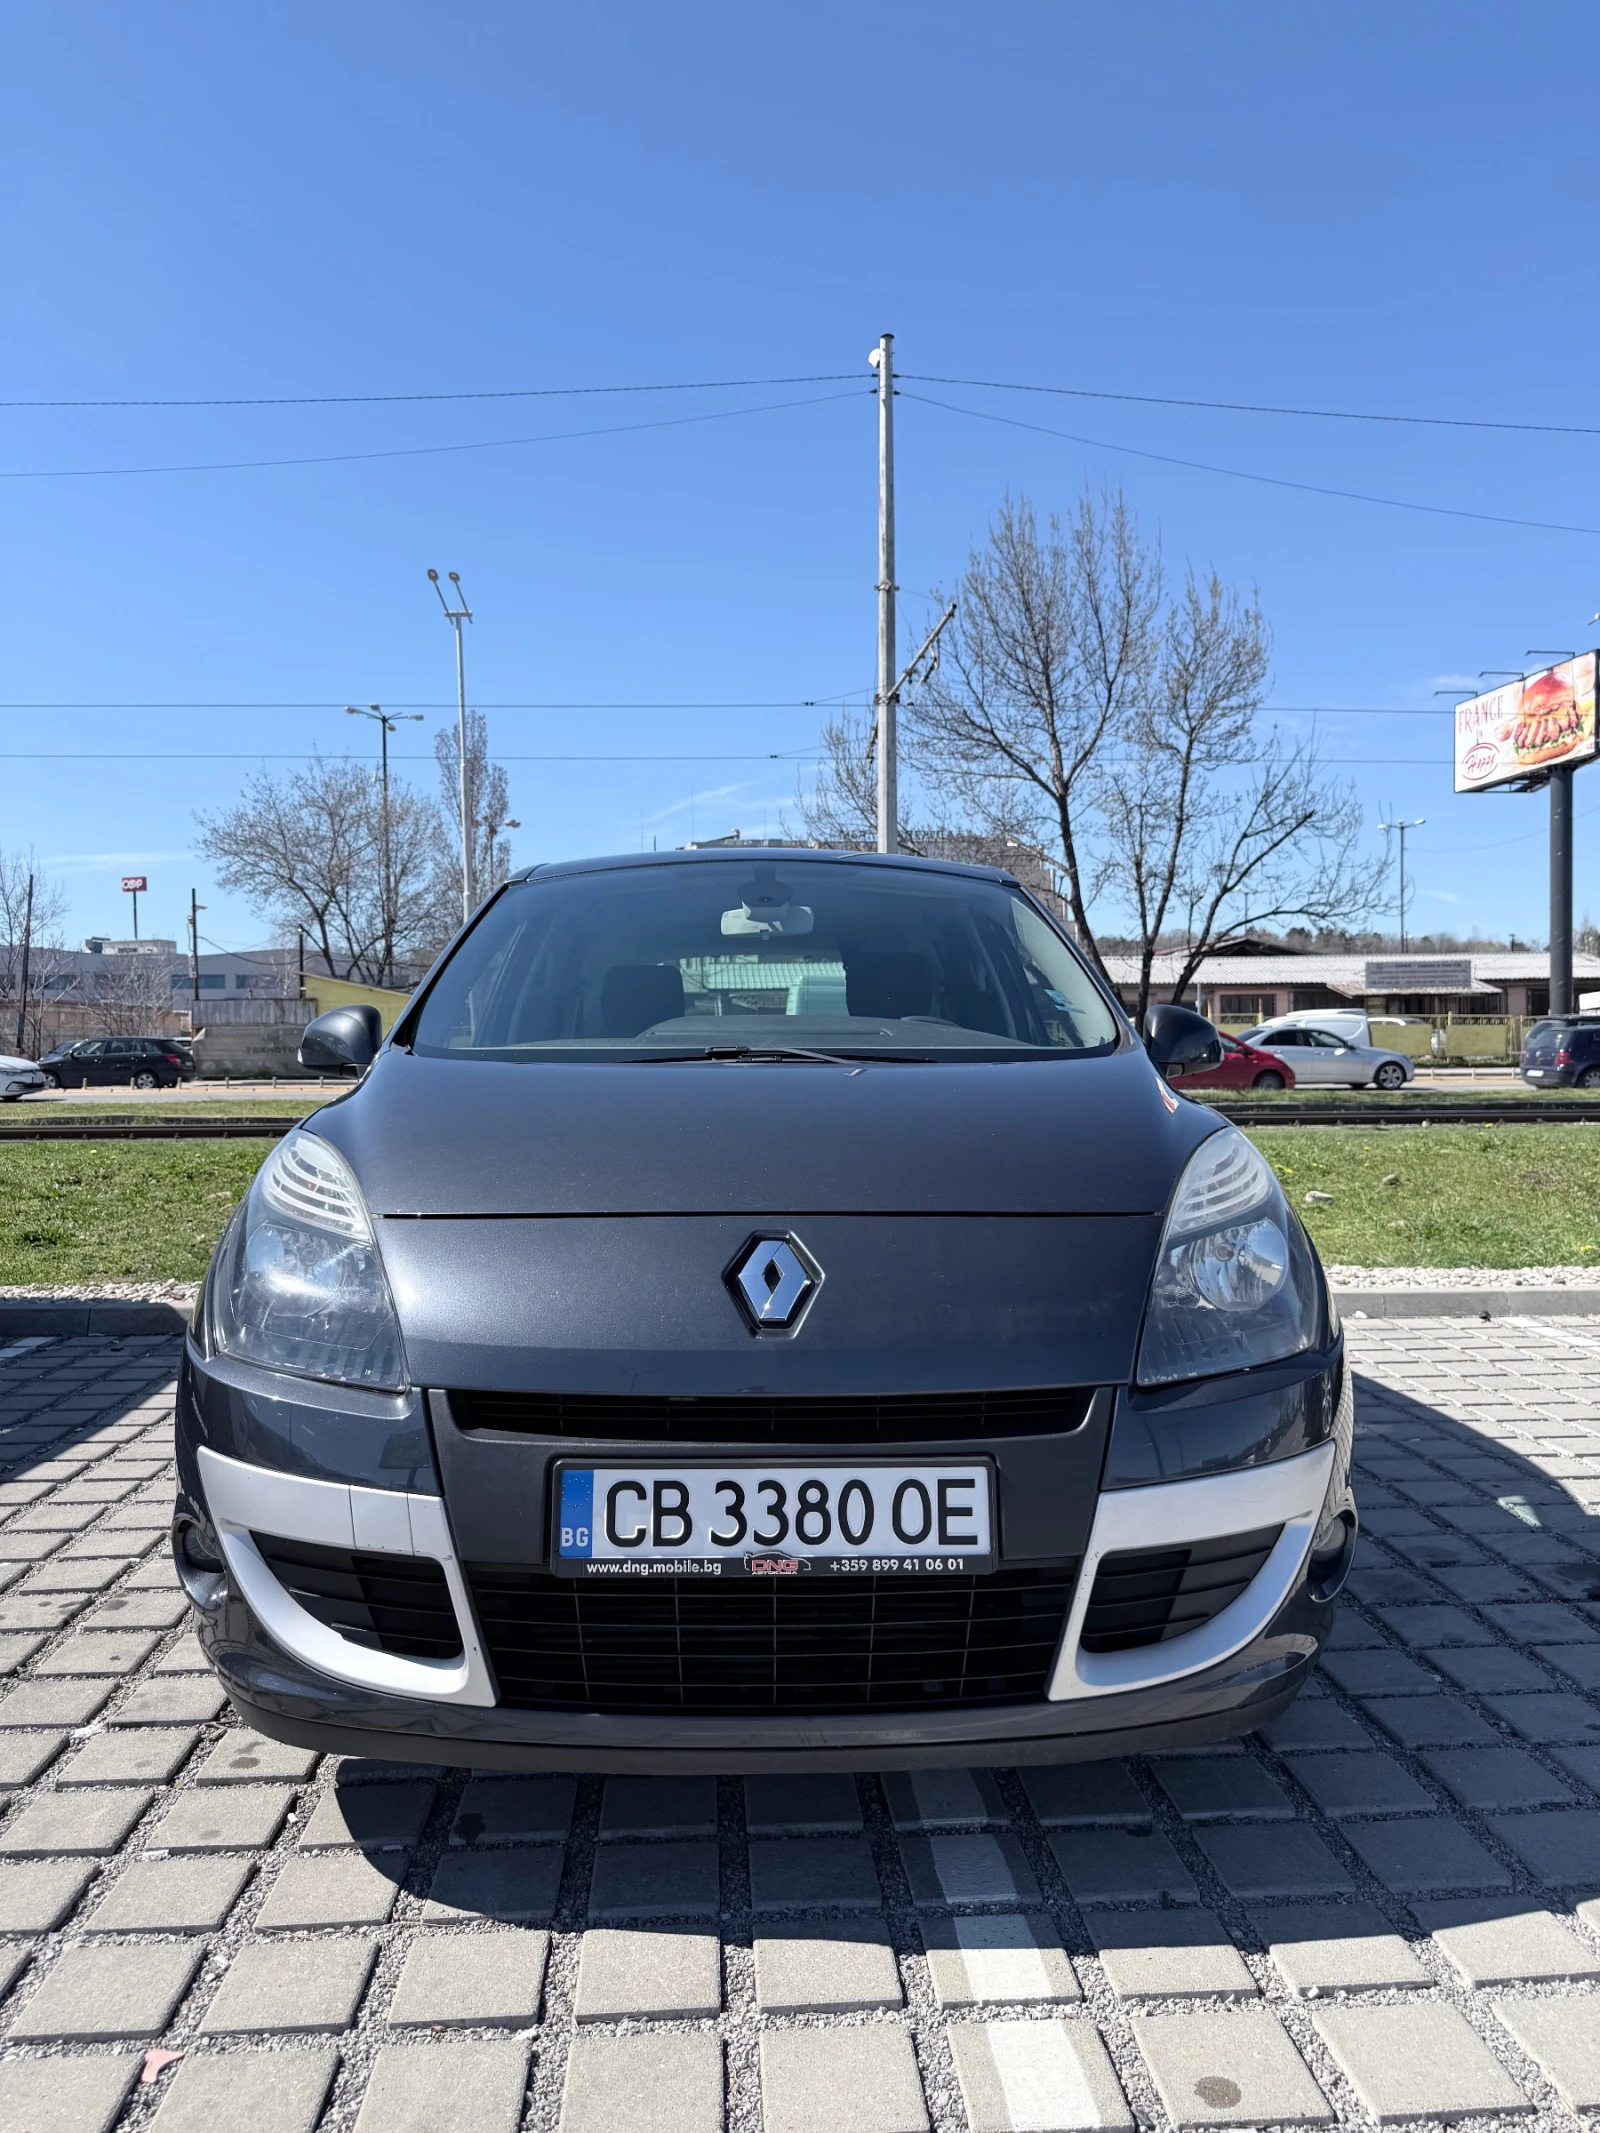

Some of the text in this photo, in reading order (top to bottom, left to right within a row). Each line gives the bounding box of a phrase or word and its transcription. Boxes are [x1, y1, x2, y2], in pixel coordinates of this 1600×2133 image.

[1458, 695, 1504, 734] FRANCE
[605, 1480, 693, 1547] CB
[709, 1479, 874, 1547] 3380
[561, 1527, 589, 1547] BG
[587, 1560, 722, 1575] www.dng.mobile.bg
[751, 1559, 799, 1571] DNG
[830, 1558, 963, 1572] +359 899 41 06 01
